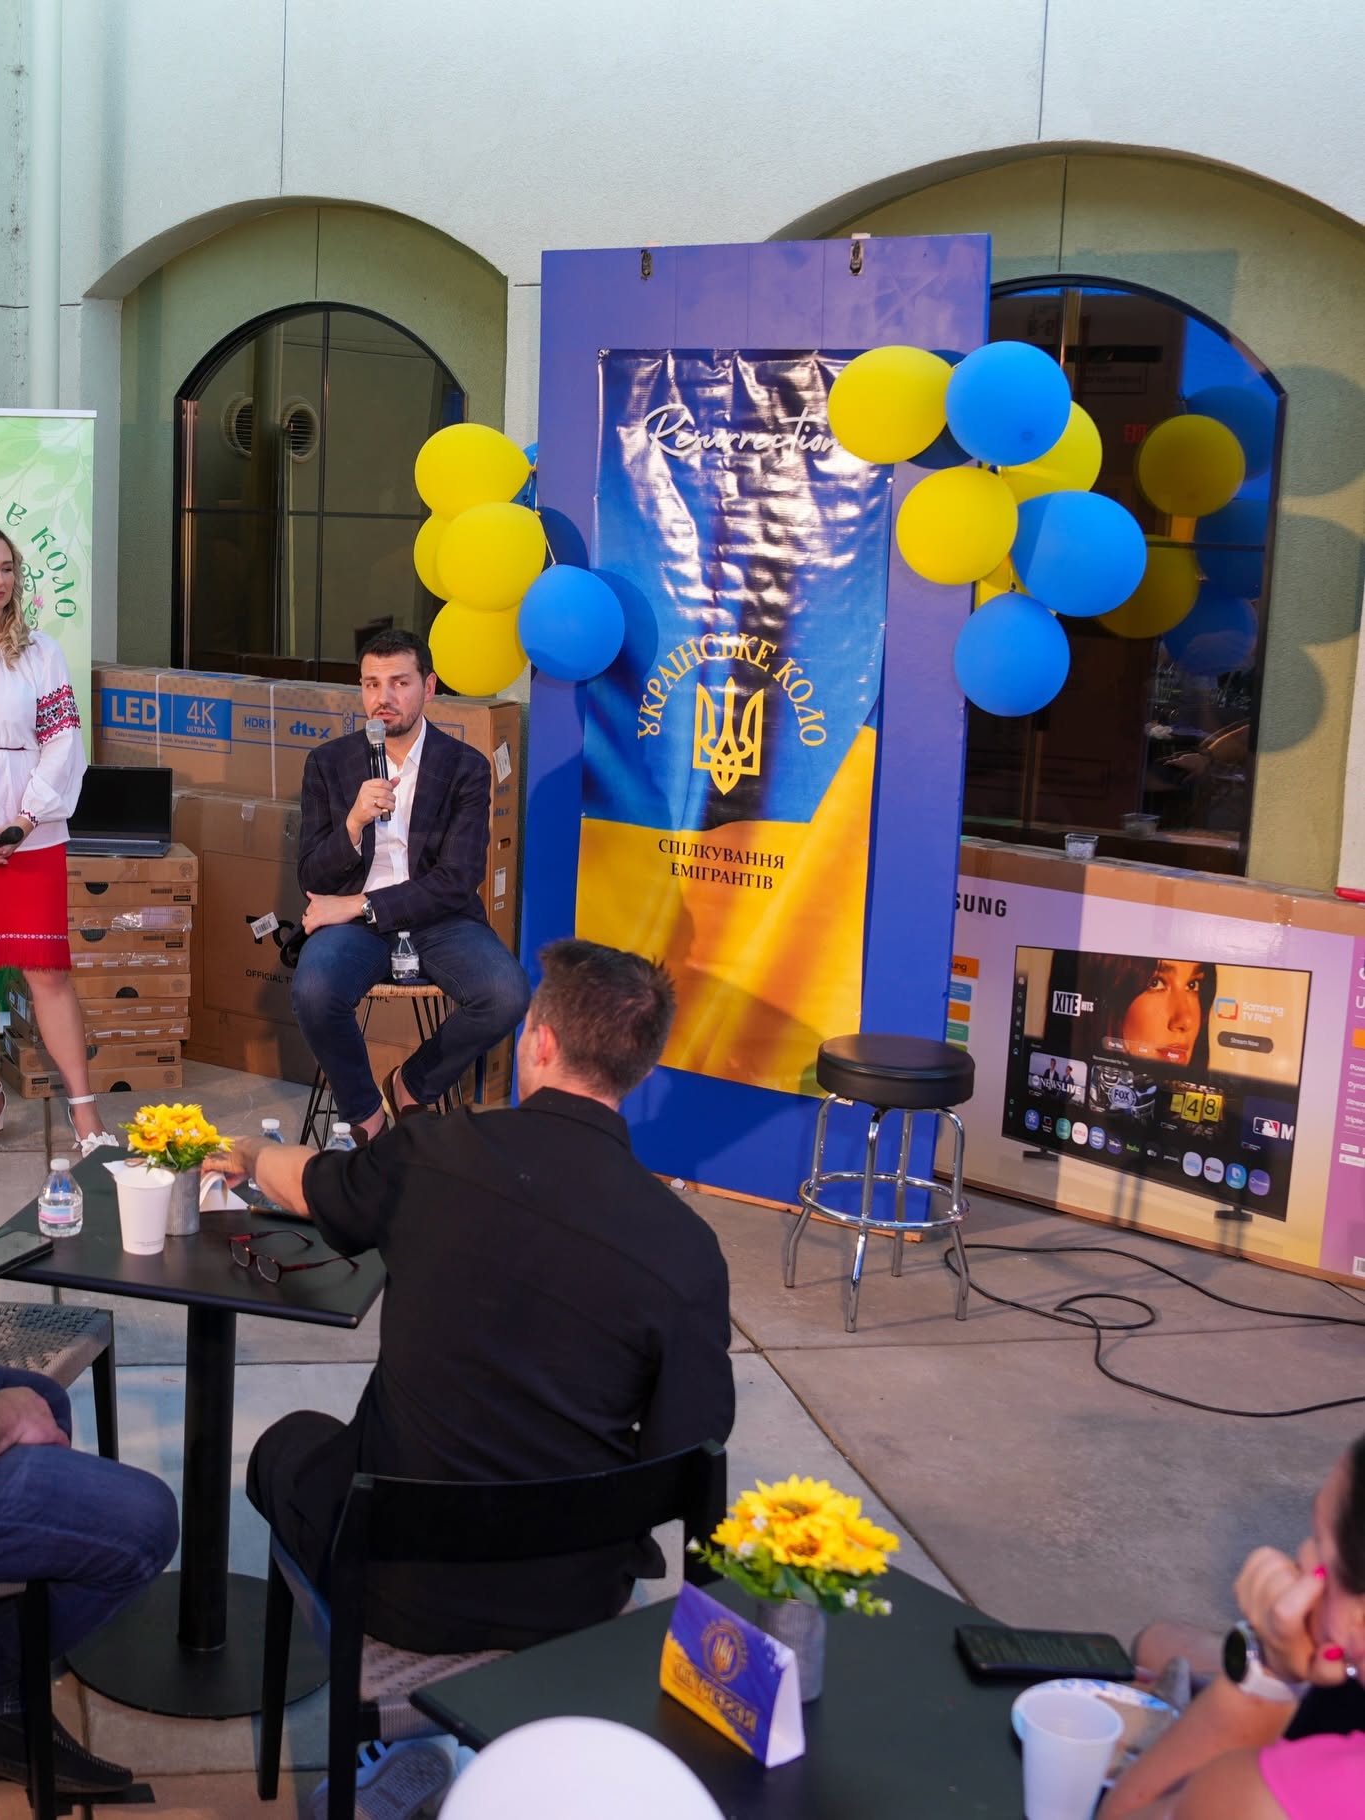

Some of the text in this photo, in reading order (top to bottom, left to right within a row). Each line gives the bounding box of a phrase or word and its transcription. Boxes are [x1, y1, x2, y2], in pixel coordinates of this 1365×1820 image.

[31, 526, 77, 618] КОЛО
[111, 695, 161, 727] LED
[186, 700, 217, 727] 4K
[773, 657, 827, 747] КОЛО
[186, 725, 217, 736] ULTRA HD
[289, 720, 316, 737] dts
[658, 838, 784, 870] СПІЛКУВАННЯ
[671, 862, 773, 890] ЕМІГРАНТІВ
[245, 968, 284, 984] OFFICIAL
[1055, 992, 1079, 1015] XITE
[1242, 1002, 1284, 1018] Samsung
[1242, 1012, 1272, 1024] TV Plus
[1113, 1088, 1130, 1101] FOX
